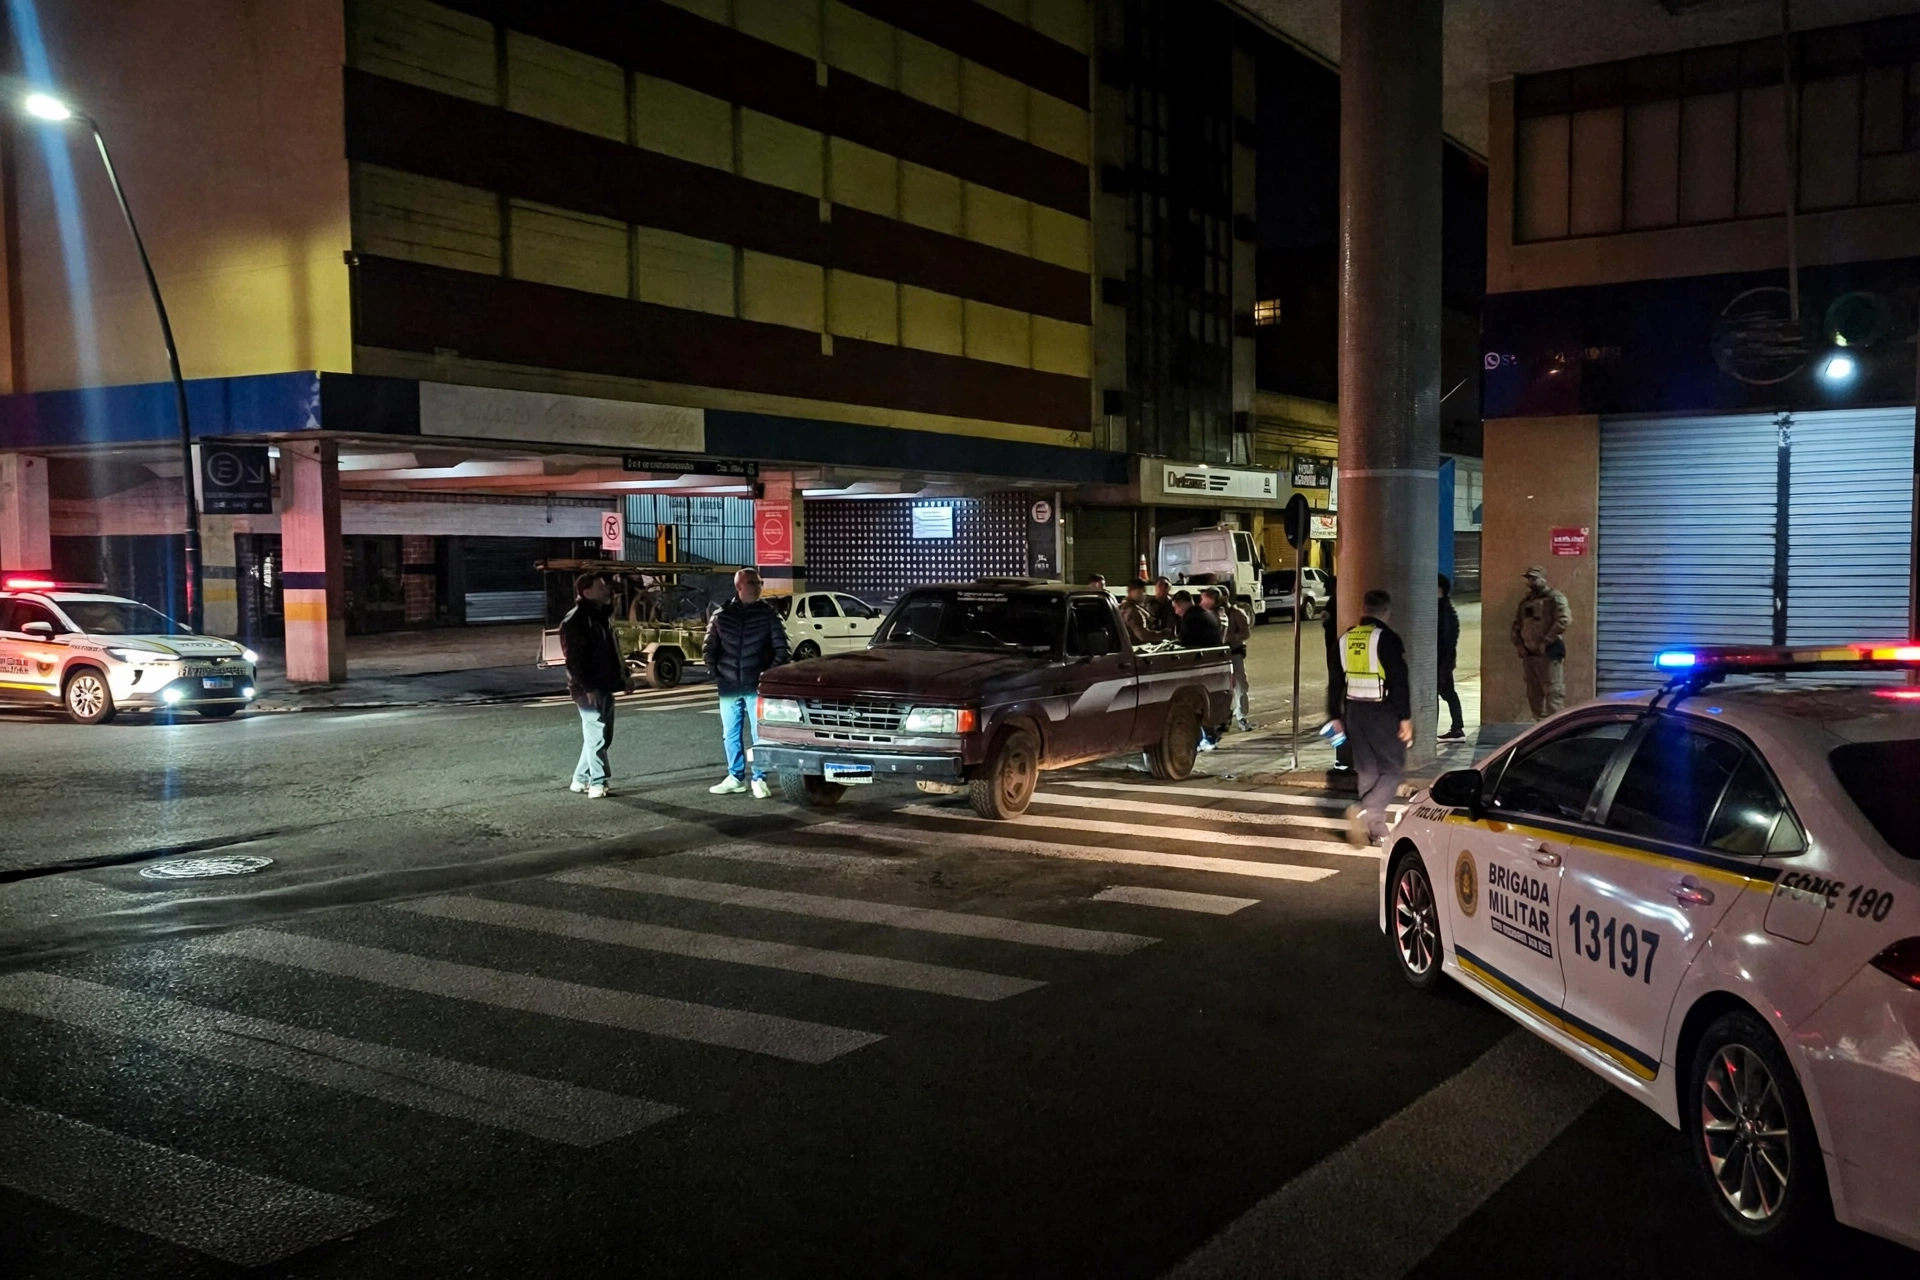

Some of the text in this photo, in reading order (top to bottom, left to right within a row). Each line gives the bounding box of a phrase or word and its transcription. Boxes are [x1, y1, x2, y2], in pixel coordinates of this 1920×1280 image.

[1489, 862, 1550, 907] BRIGADA
[1846, 884, 1894, 922] 190
[1489, 889, 1551, 937] MILITAR
[1569, 903, 1660, 985] 13197
